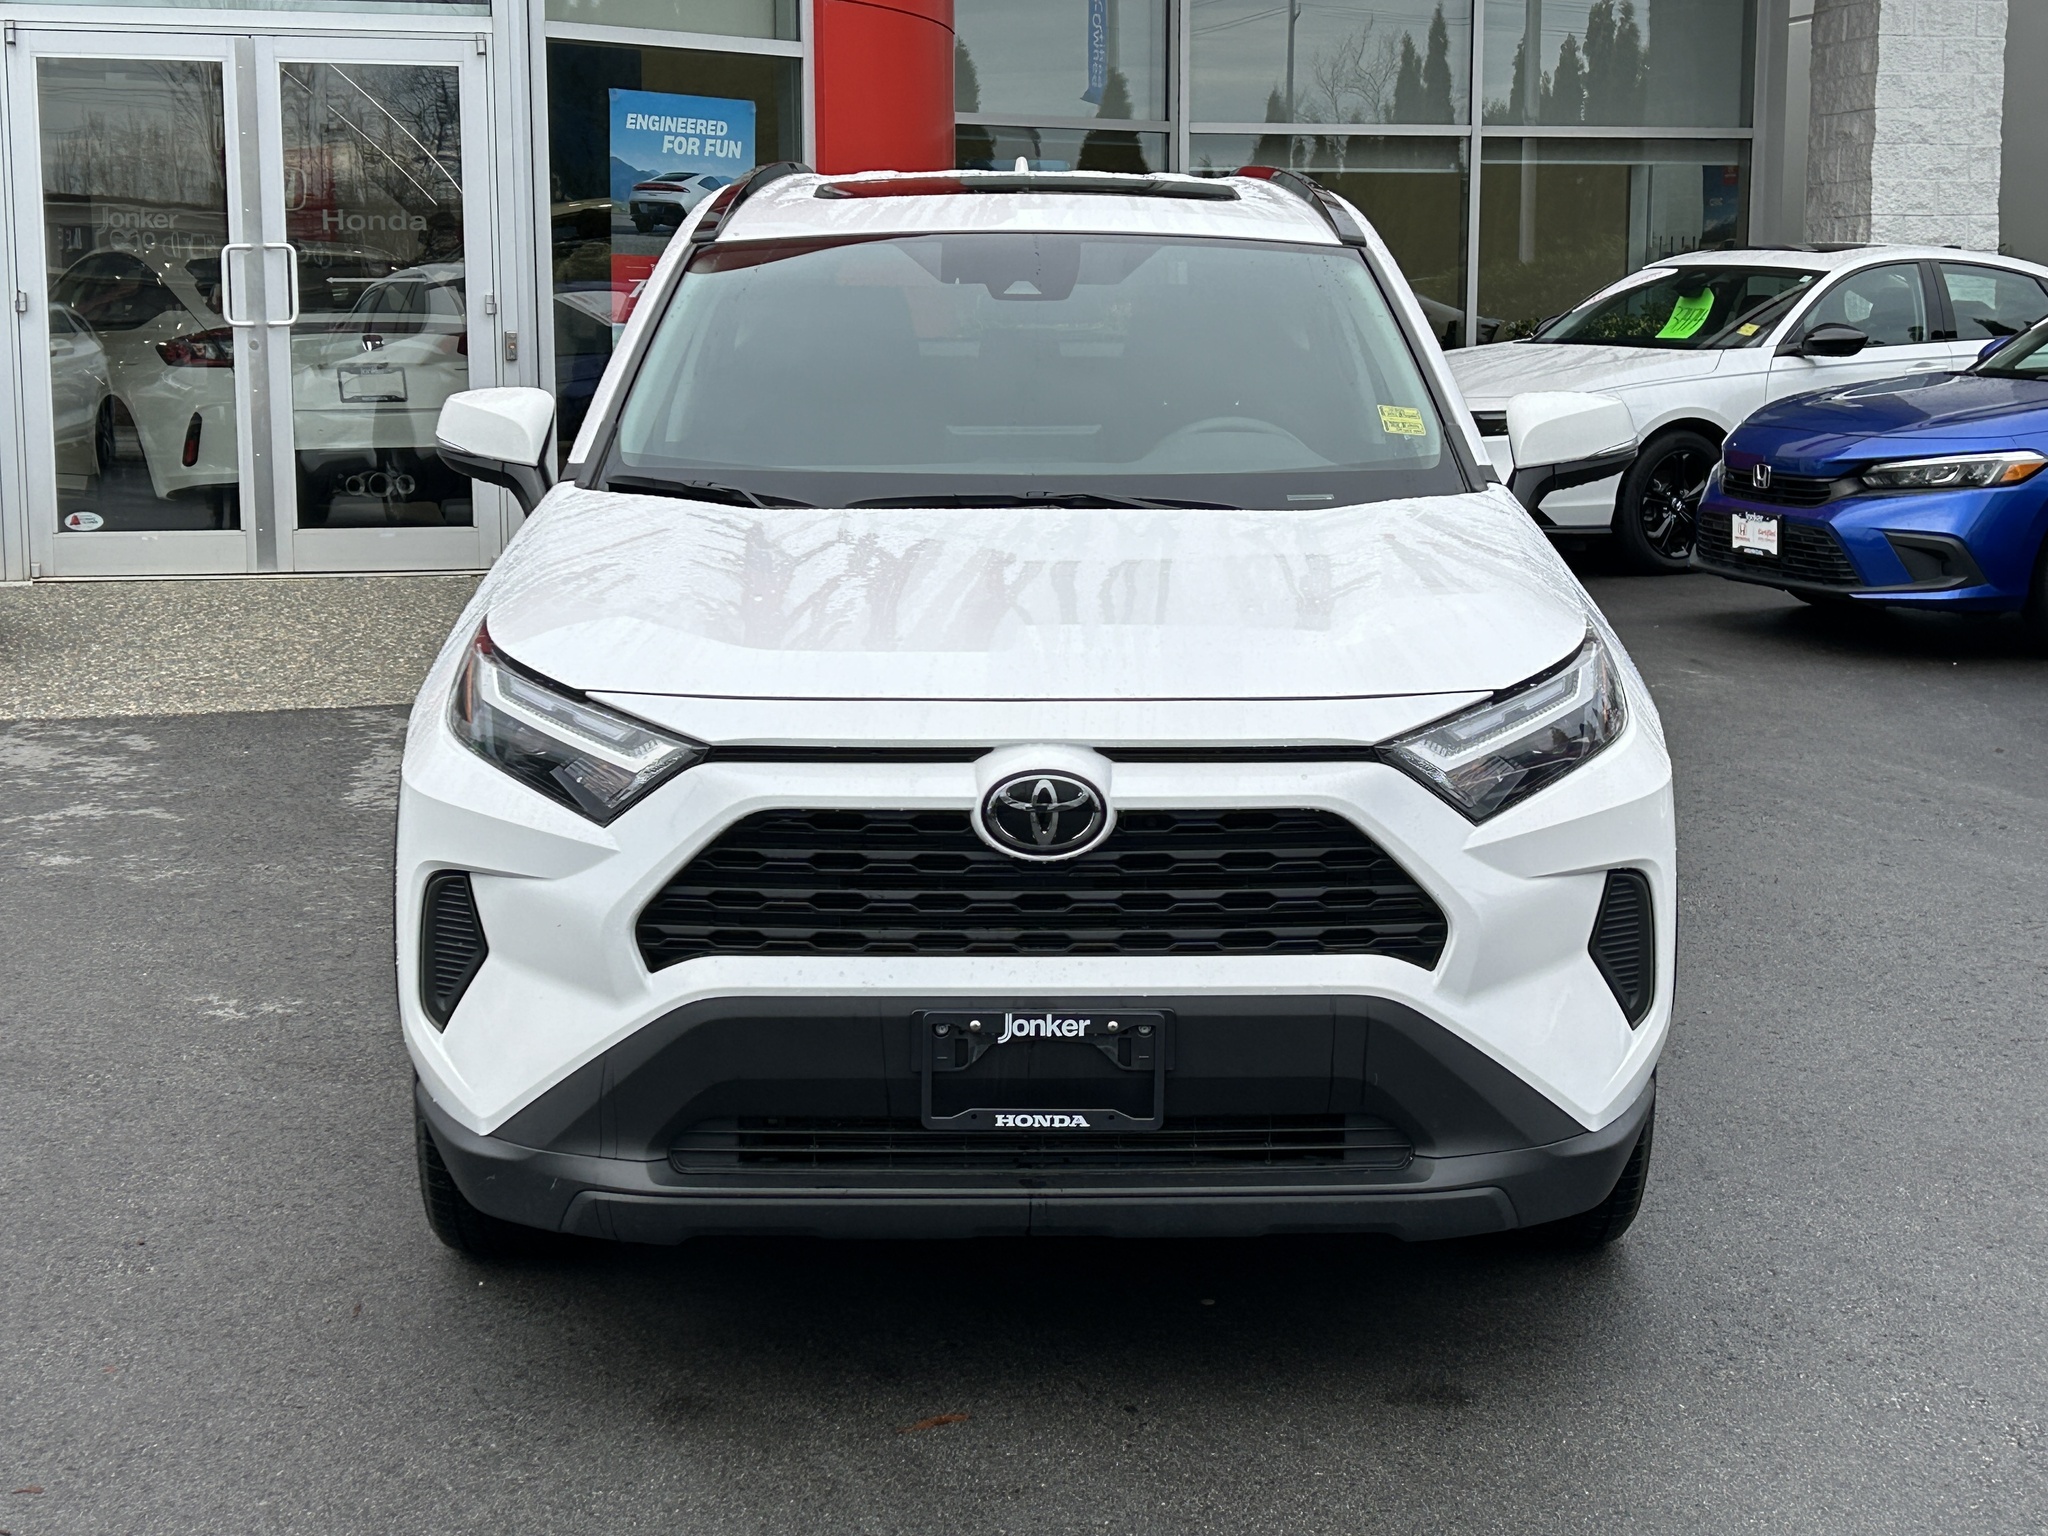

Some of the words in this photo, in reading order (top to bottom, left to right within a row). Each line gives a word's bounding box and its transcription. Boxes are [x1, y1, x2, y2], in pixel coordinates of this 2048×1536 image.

[626, 113, 728, 136] ENGINEERED
[661, 135, 700, 156] FOR
[703, 138, 742, 159] FUN
[97, 206, 179, 234] Jonker
[321, 208, 428, 231] Honda
[997, 1013, 1091, 1044] Jonker
[995, 1114, 1090, 1128] HONDA
